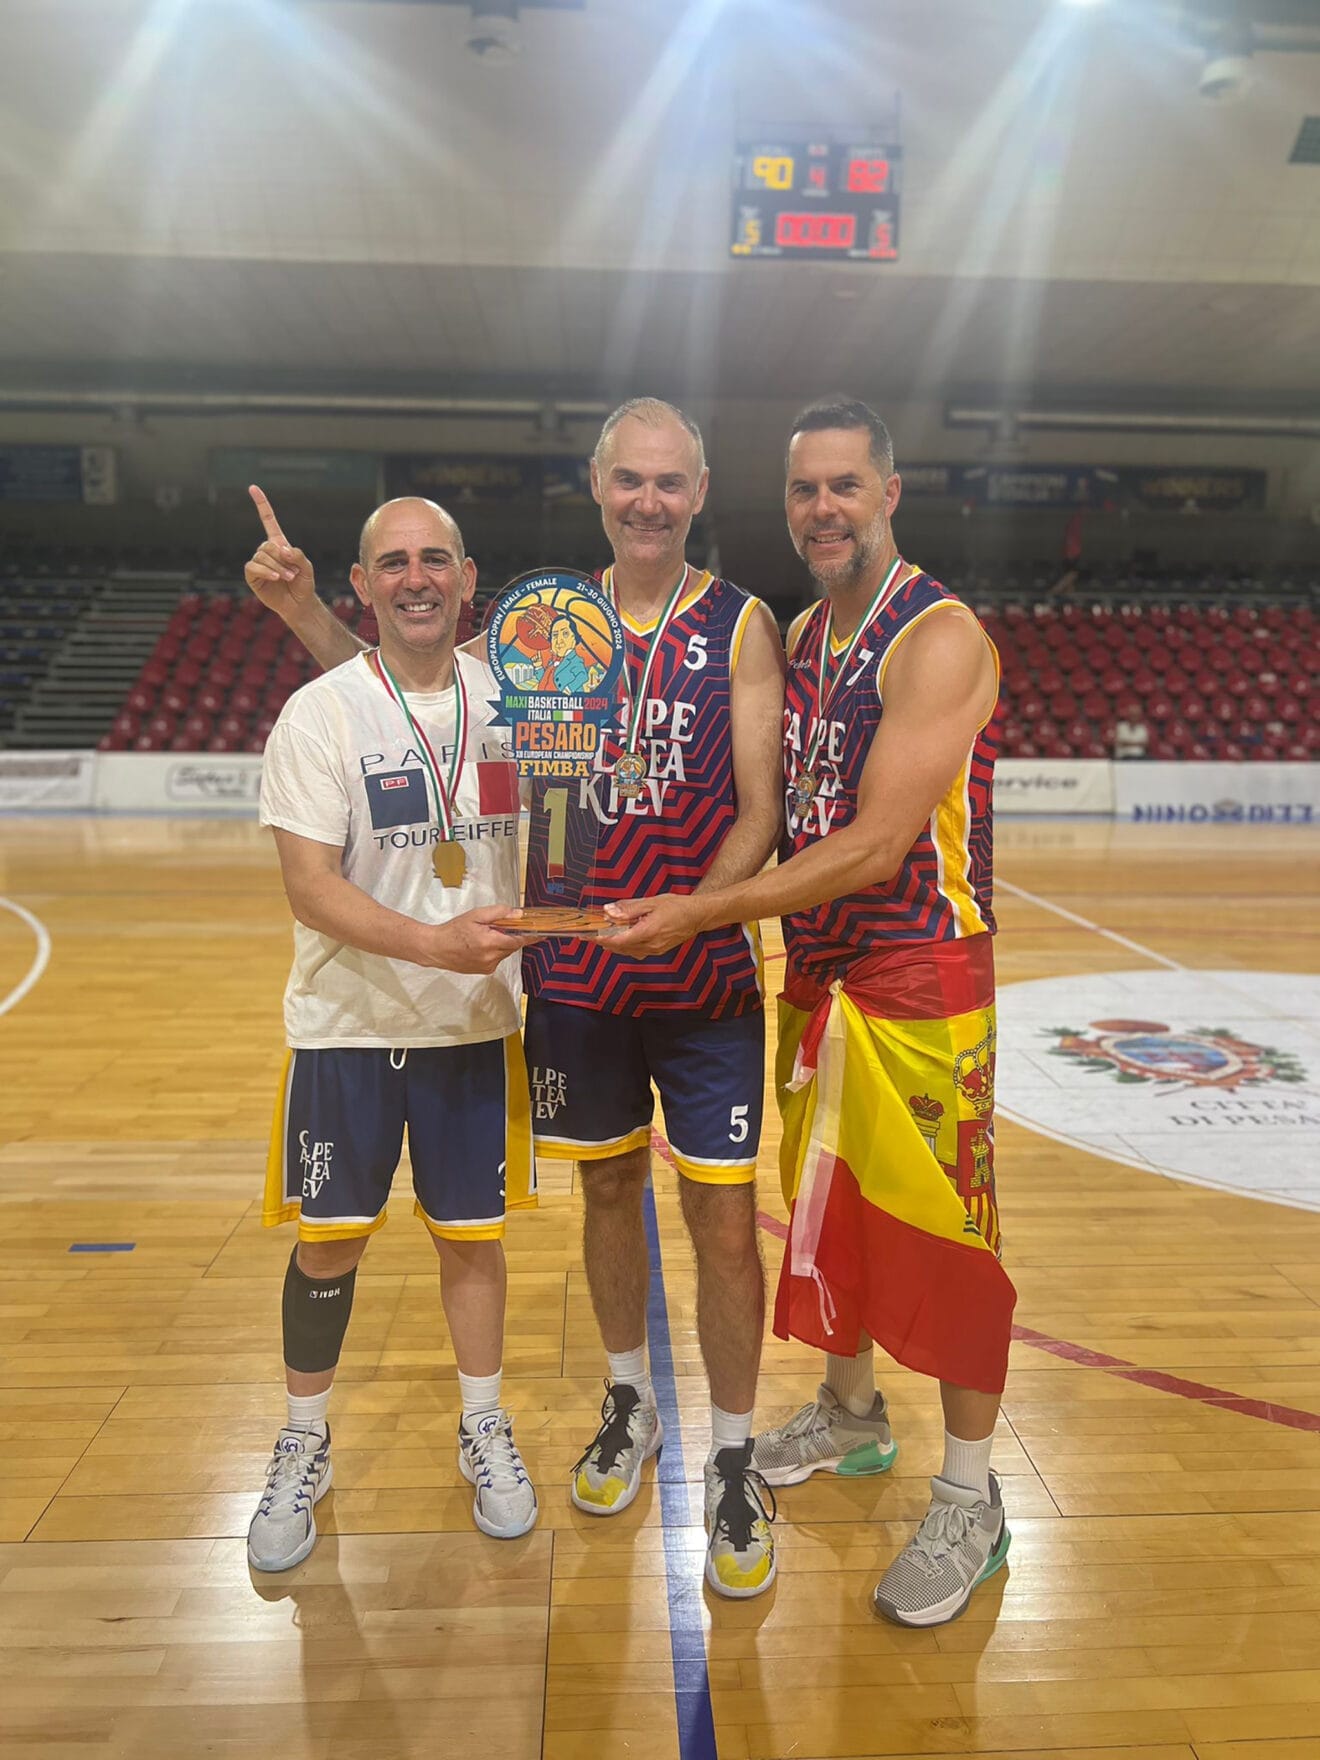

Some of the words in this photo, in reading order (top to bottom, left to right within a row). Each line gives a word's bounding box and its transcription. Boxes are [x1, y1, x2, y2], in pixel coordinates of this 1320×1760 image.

[753, 156, 794, 190] 90
[502, 590, 521, 609] MALE
[526, 578, 557, 591] FEMALE
[491, 615, 504, 636] OPEN
[576, 582, 598, 599] 21-30
[597, 598, 618, 628] GIUGNO
[613, 629, 622, 650] 2024
[490, 637, 506, 681] EUROPEAN
[683, 634, 708, 671] 5
[846, 648, 875, 687] 7
[528, 710, 551, 721] ITALIA
[516, 722, 597, 751] PESARO
[519, 760, 590, 777] FIMBA
[374, 828, 440, 850] TOUR
[452, 820, 518, 841] EIFFE
[543, 787, 569, 878] 1
[728, 1104, 749, 1143] 5
